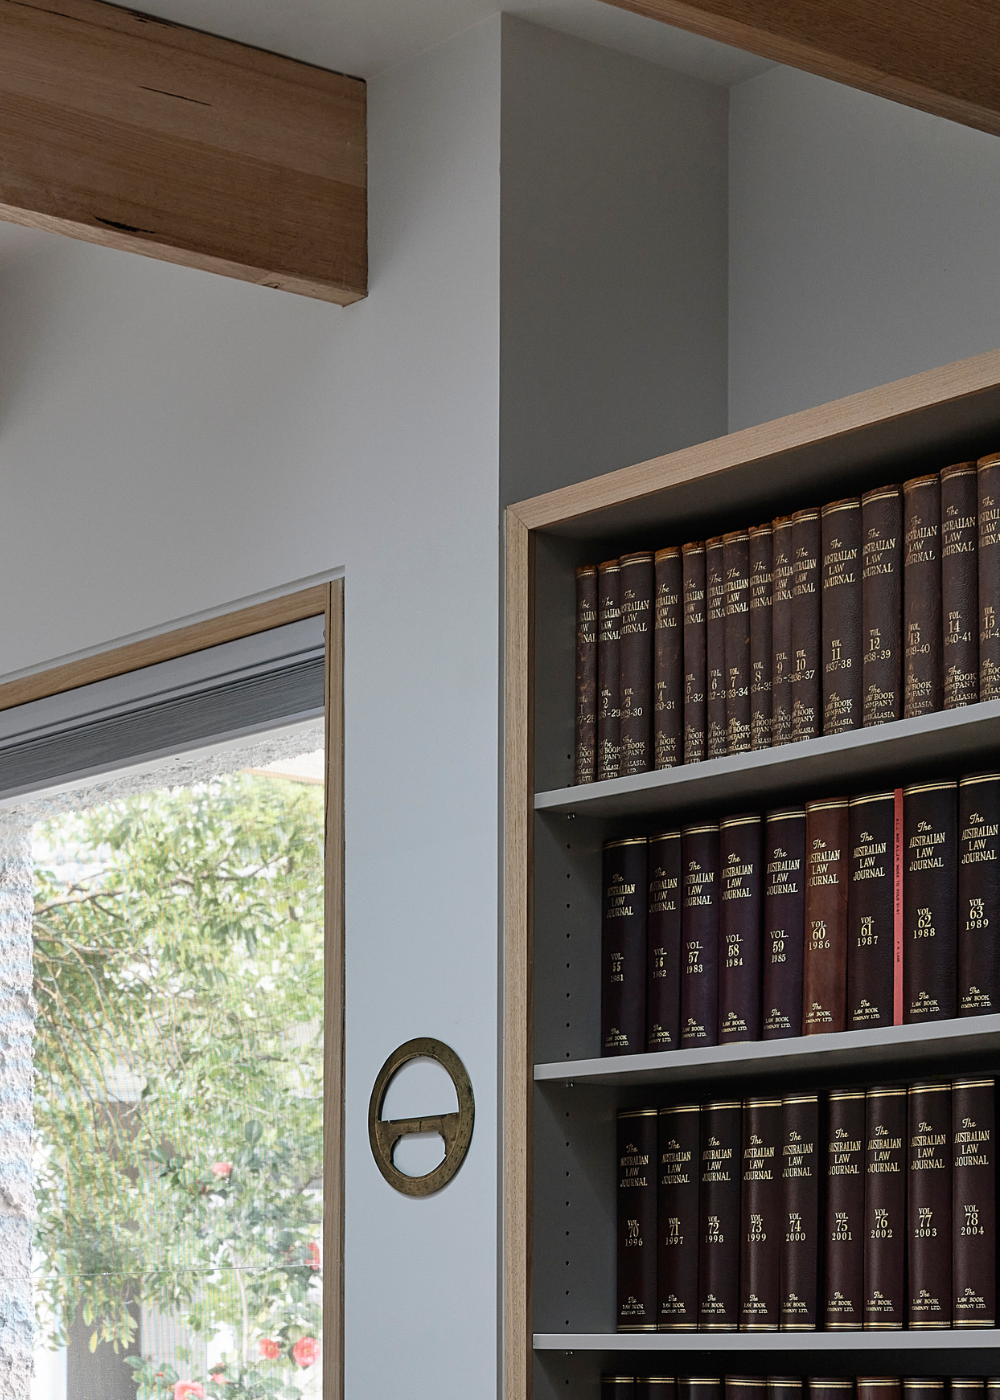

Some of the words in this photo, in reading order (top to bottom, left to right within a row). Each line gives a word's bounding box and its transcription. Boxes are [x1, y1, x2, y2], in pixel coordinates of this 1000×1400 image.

[831, 539, 842, 549] The
[828, 563, 845, 575] LAW
[824, 572, 855, 588] JOURNAL
[831, 648, 841, 661] 11
[970, 813, 984, 824] The
[918, 821, 932, 832] The
[860, 832, 873, 842] The
[962, 825, 998, 840] AUSTRALIAN
[909, 832, 945, 848] AUSTRALIAN
[969, 839, 986, 851] LAW
[853, 843, 886, 858] AUSTRALIAN
[917, 847, 934, 858] LAW
[859, 857, 875, 868] LAW
[962, 850, 997, 864] JOURNAL
[909, 857, 944, 871] JOURNAL
[853, 868, 885, 882] JOURNAL
[969, 898, 984, 906] VOL.
[970, 906, 983, 919] 63
[861, 916, 874, 924] VOL.
[918, 915, 932, 928] 62
[965, 920, 988, 930] 1989
[861, 923, 873, 936] 61
[913, 928, 935, 939] 1988
[857, 936, 878, 946] 1987
[919, 1122, 933, 1132] The
[962, 1118, 977, 1128] The
[911, 1134, 946, 1147] AUSTRALIAN
[955, 1130, 990, 1143] AUSTRALIAN
[917, 1148, 934, 1158] LAW
[961, 1144, 978, 1154] LAW
[911, 1159, 945, 1170] JOURNAL
[955, 1155, 988, 1166] JOURNAL
[919, 1215, 932, 1227] 77
[965, 1213, 978, 1225] 78
[915, 1228, 937, 1237] 2003
[961, 1226, 984, 1235] 2004
